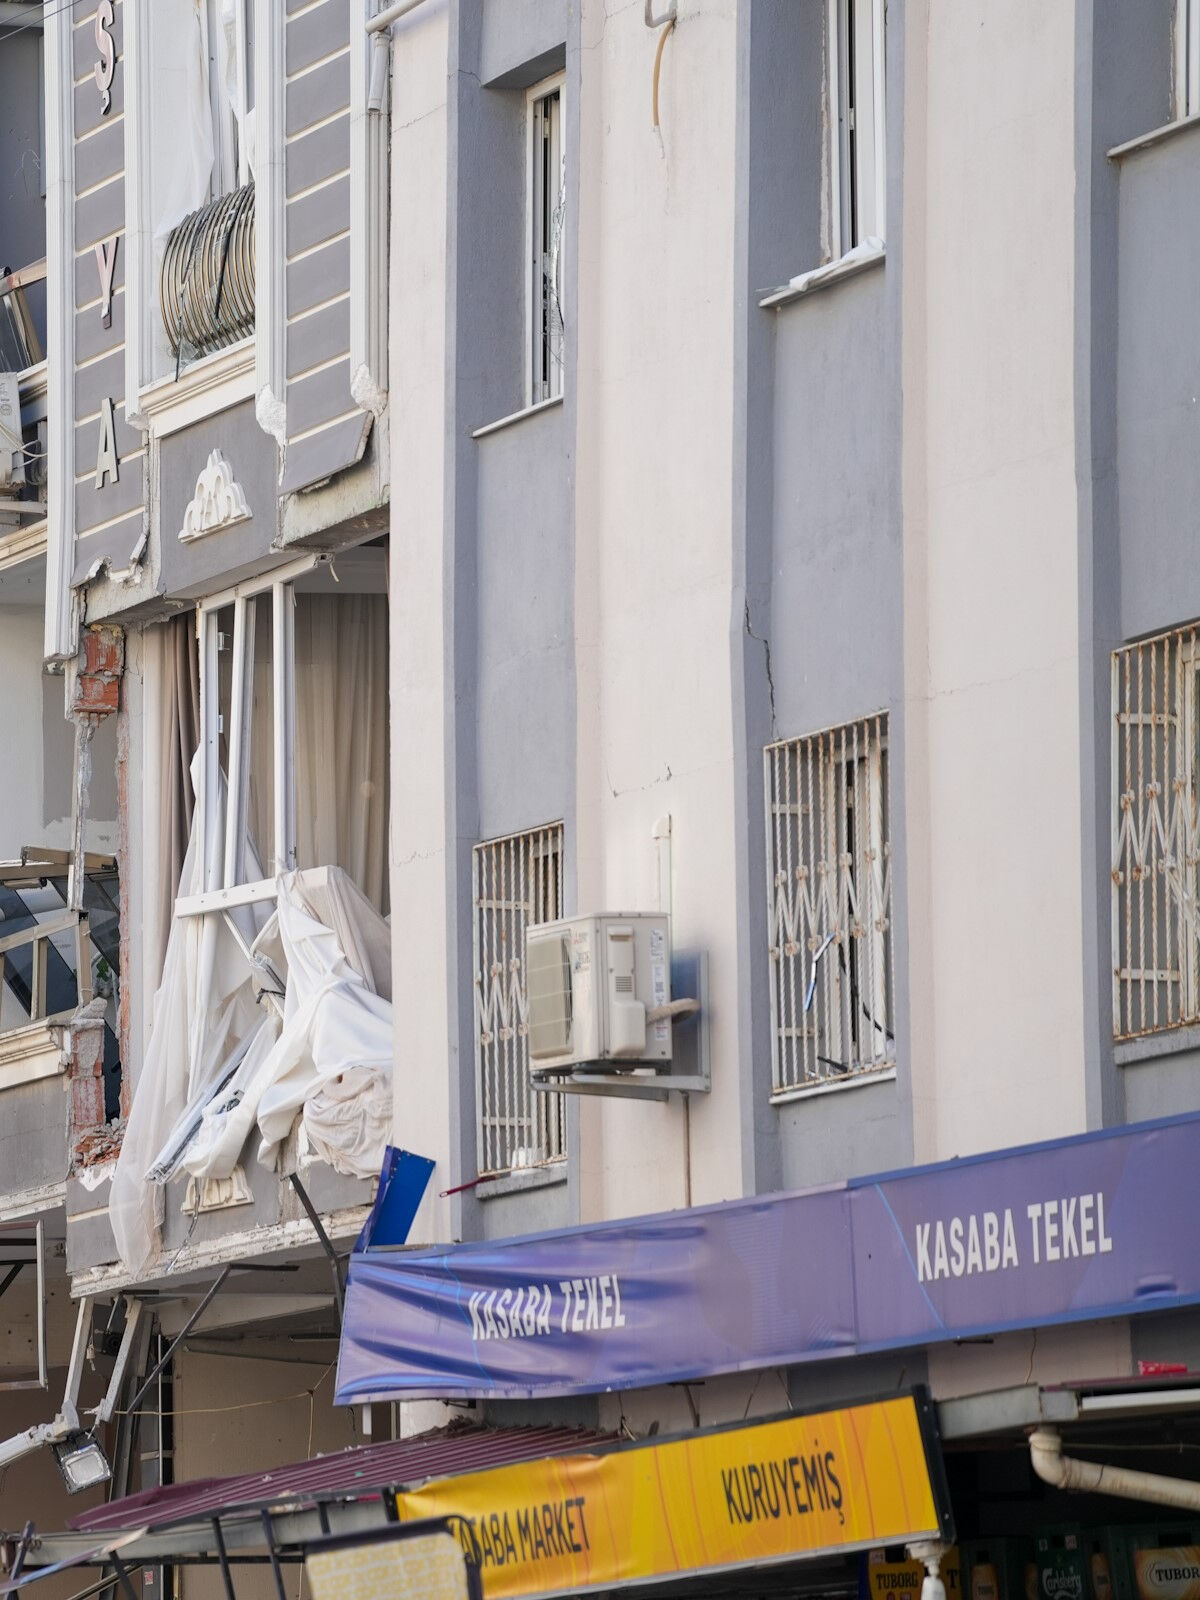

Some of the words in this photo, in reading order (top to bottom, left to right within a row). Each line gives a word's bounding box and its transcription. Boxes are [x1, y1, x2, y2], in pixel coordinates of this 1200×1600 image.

[916, 1208, 1019, 1282] KASABA
[1027, 1192, 1113, 1264] TEKEL
[468, 1284, 552, 1341] KASABA
[559, 1274, 626, 1333] TEKEL
[721, 1438, 845, 1525] KURUYEMİŞ
[515, 1497, 590, 1561] MARKET
[876, 1571, 918, 1590] TUBORG
[1042, 1567, 1082, 1597] Carlsberg
